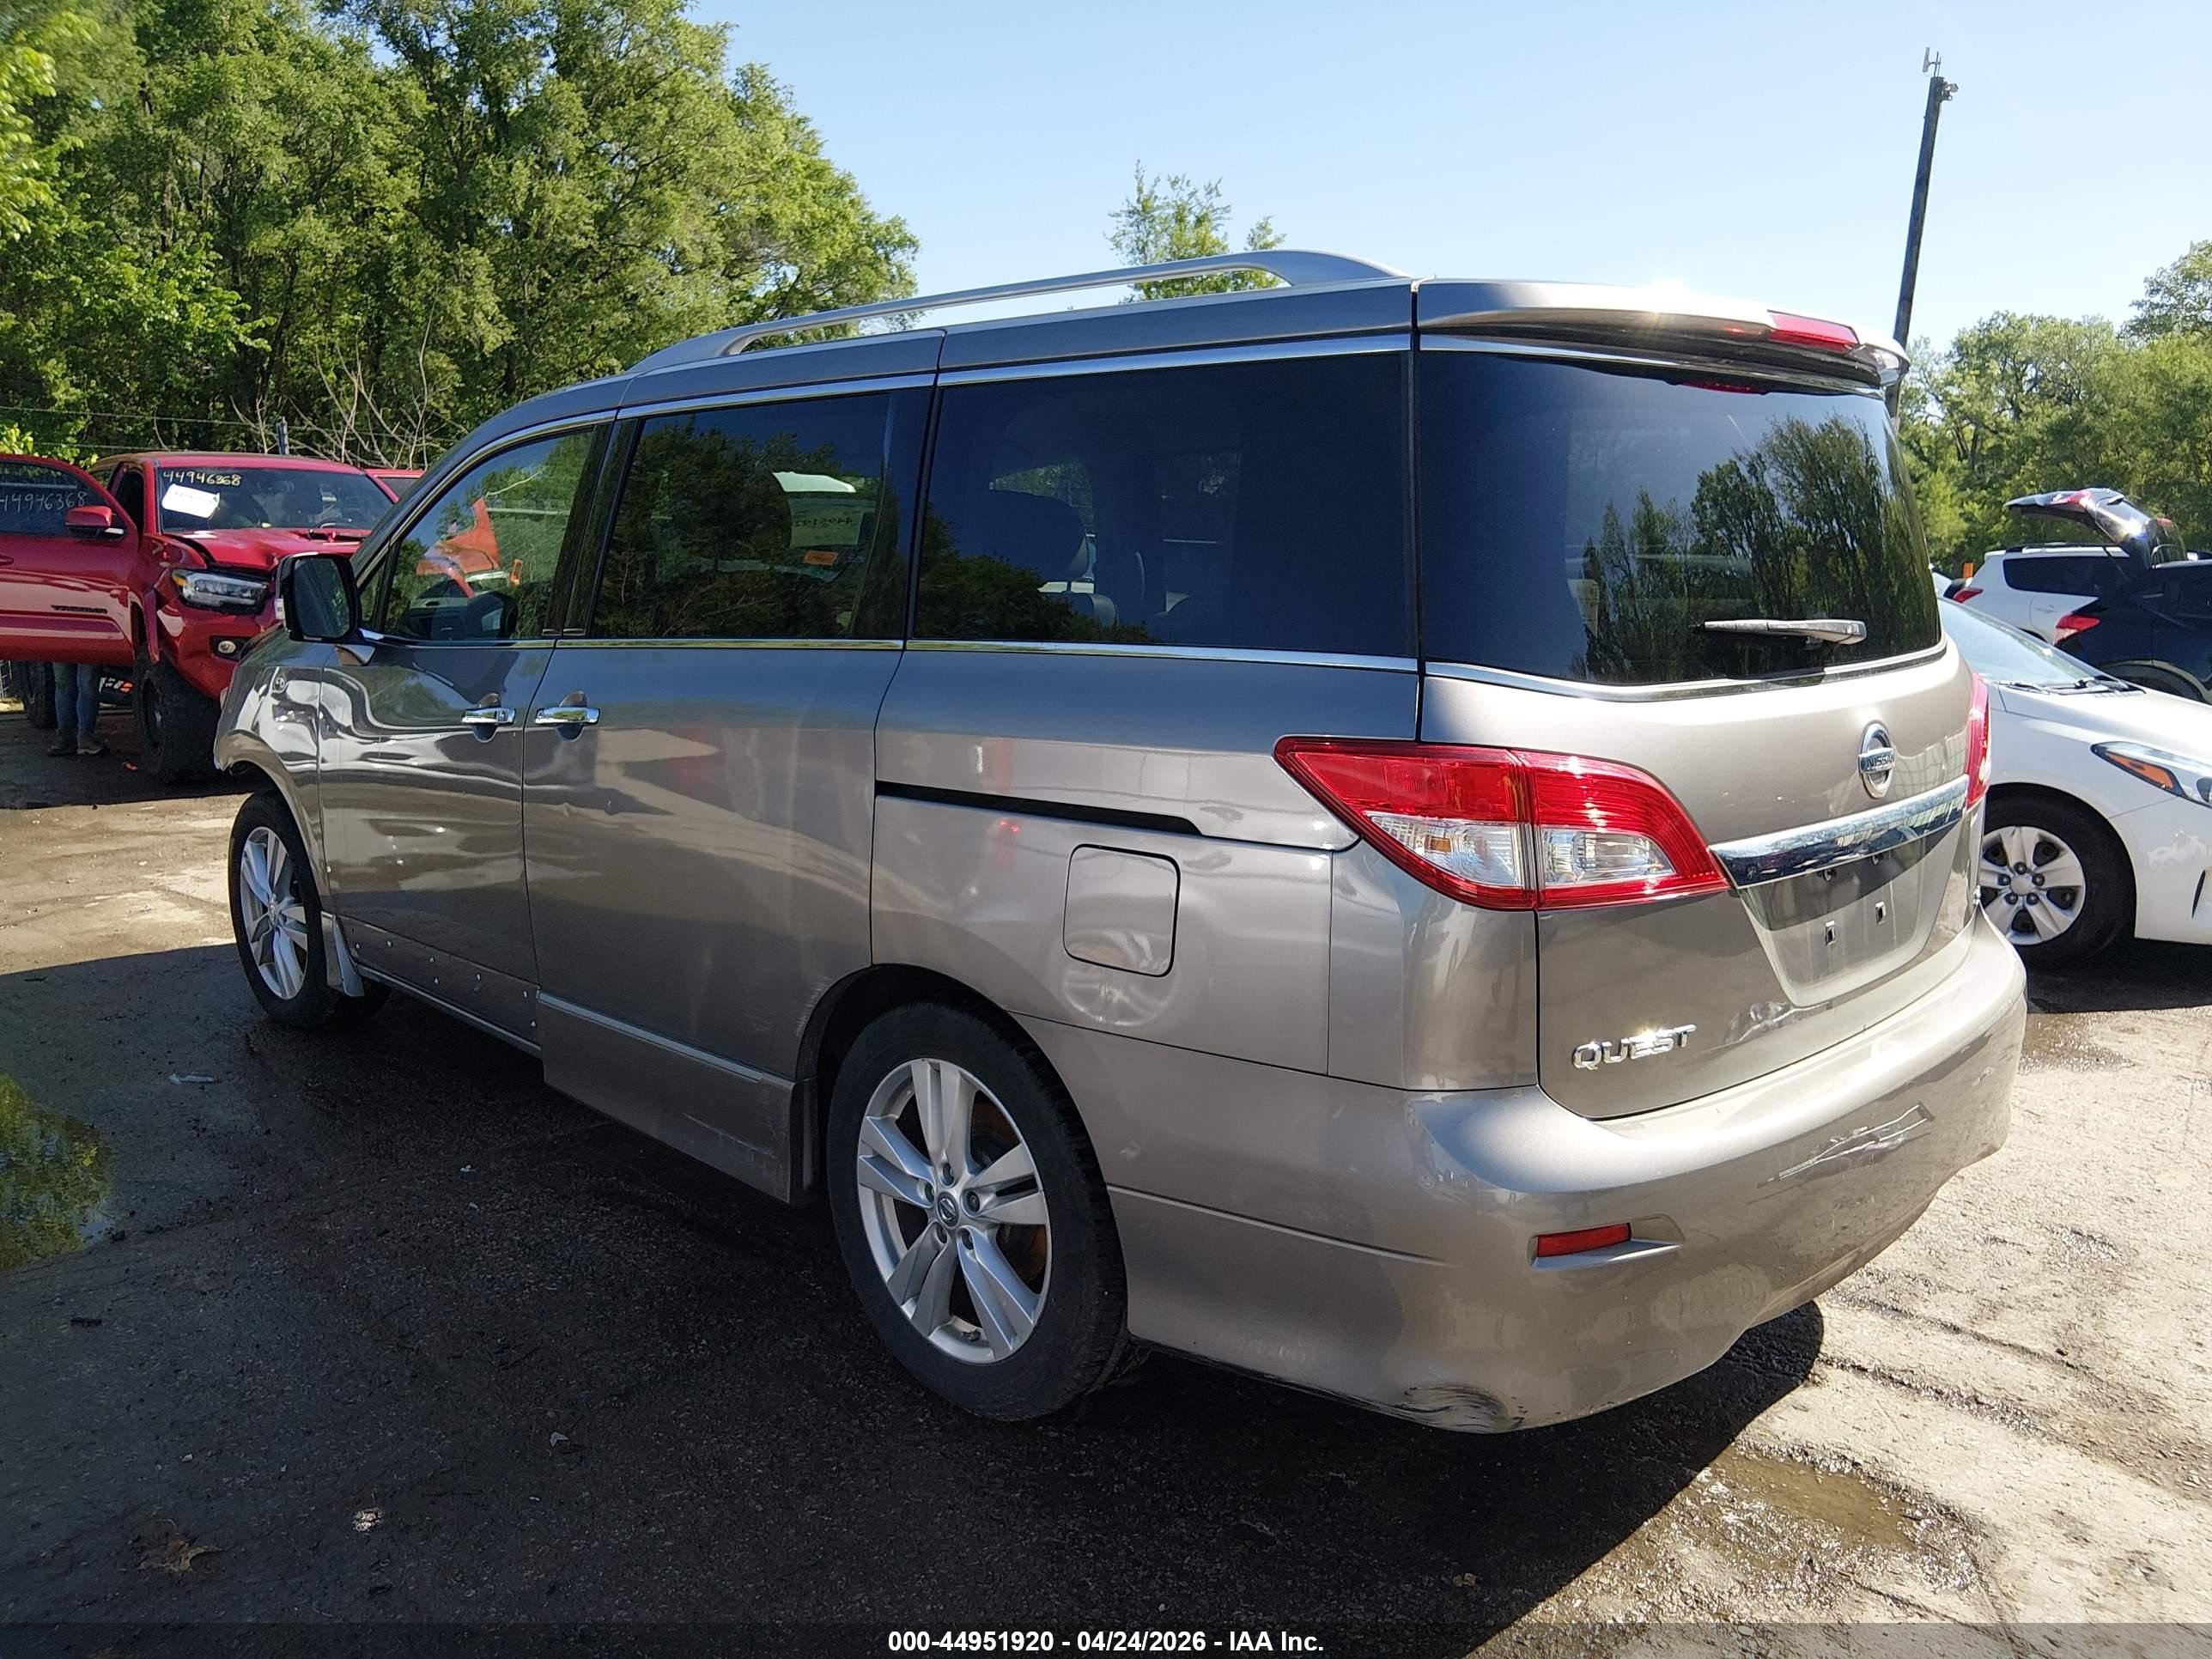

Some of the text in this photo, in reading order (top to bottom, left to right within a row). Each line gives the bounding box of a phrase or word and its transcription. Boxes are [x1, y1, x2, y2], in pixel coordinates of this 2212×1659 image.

[163, 471, 241, 487] 44946368
[1867, 751, 1895, 768] NISSAN
[1572, 1024, 1697, 1071] QUEST
